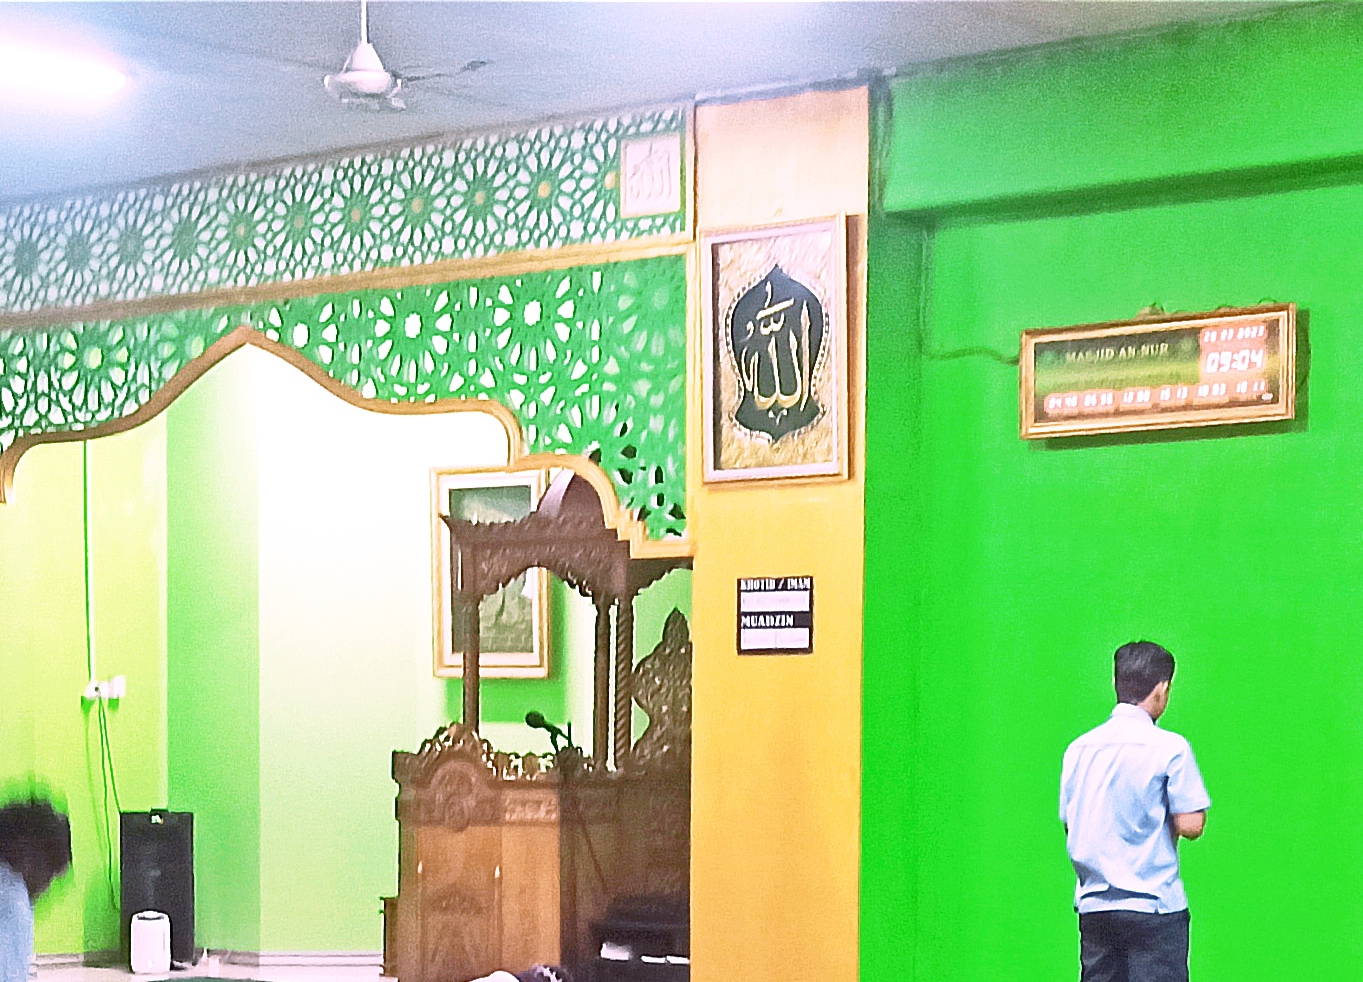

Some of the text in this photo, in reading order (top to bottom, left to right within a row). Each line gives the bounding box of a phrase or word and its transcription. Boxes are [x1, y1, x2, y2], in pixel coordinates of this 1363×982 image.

[1205, 348, 1265, 373] 09:04
[786, 576, 811, 590] IMAM
[740, 614, 794, 628] MUADZIN
